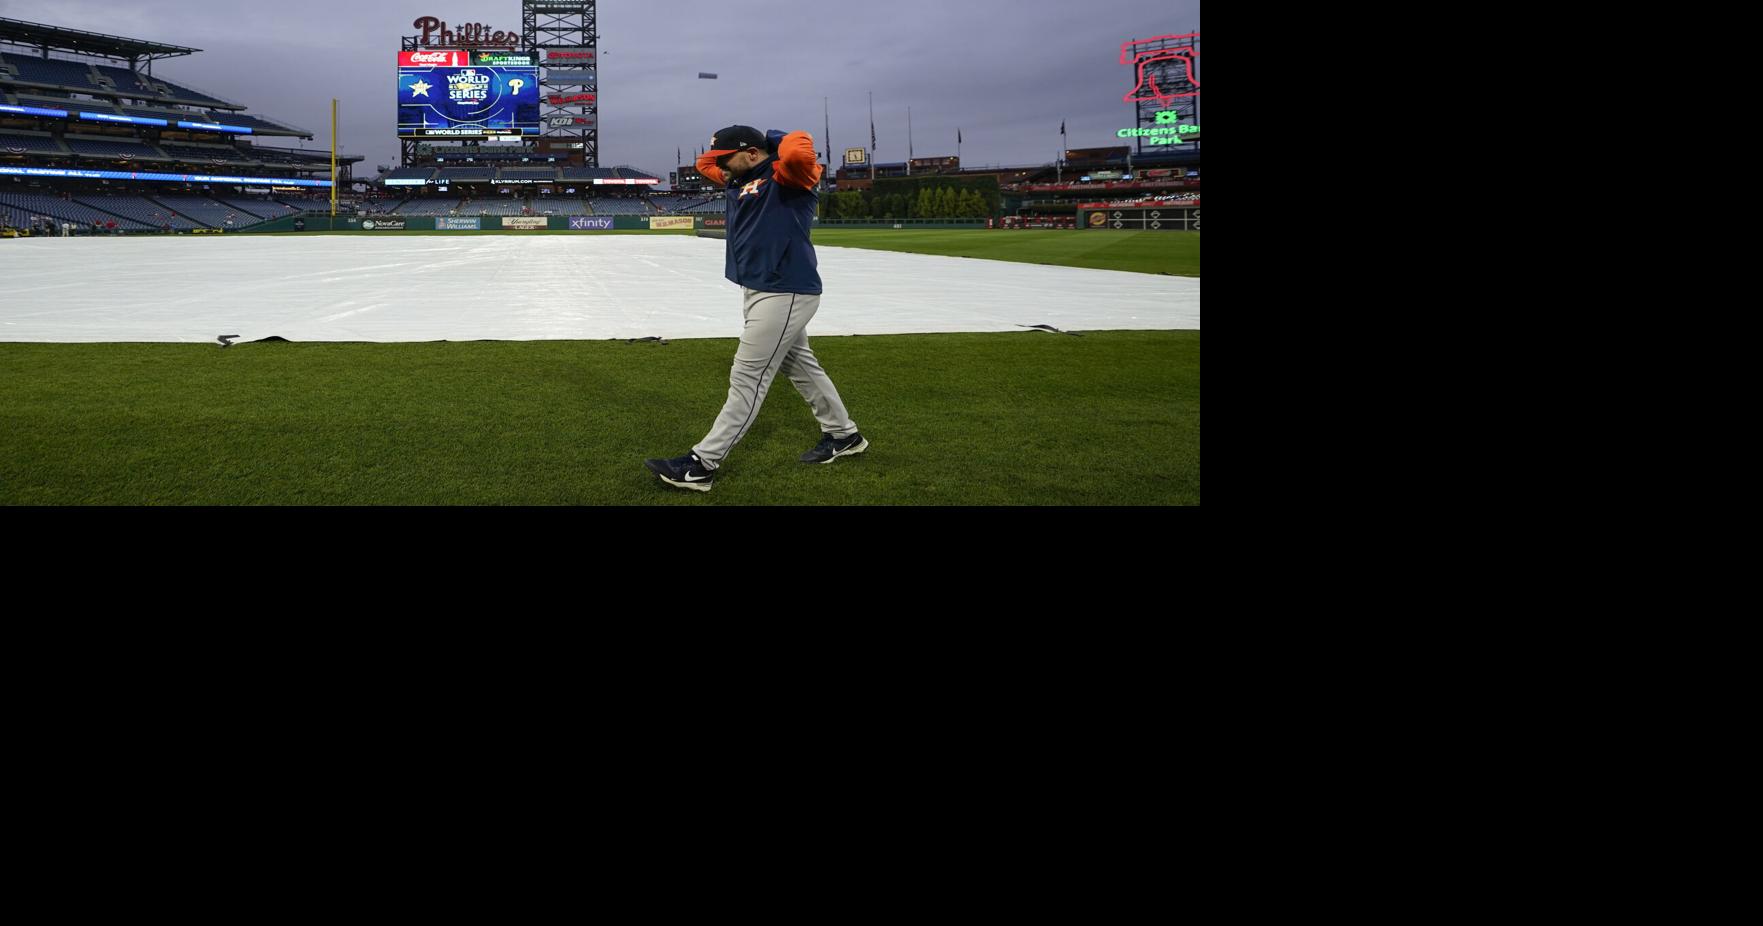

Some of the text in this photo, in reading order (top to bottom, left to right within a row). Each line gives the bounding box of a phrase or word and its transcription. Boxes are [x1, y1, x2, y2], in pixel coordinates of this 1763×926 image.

[413, 16, 519, 45] Phillies
[447, 75, 490, 84] WORLD
[449, 90, 487, 99] SERIES
[1116, 127, 1177, 138] Citizens
[1149, 135, 1183, 145] Park
[571, 218, 612, 229] xfinity
